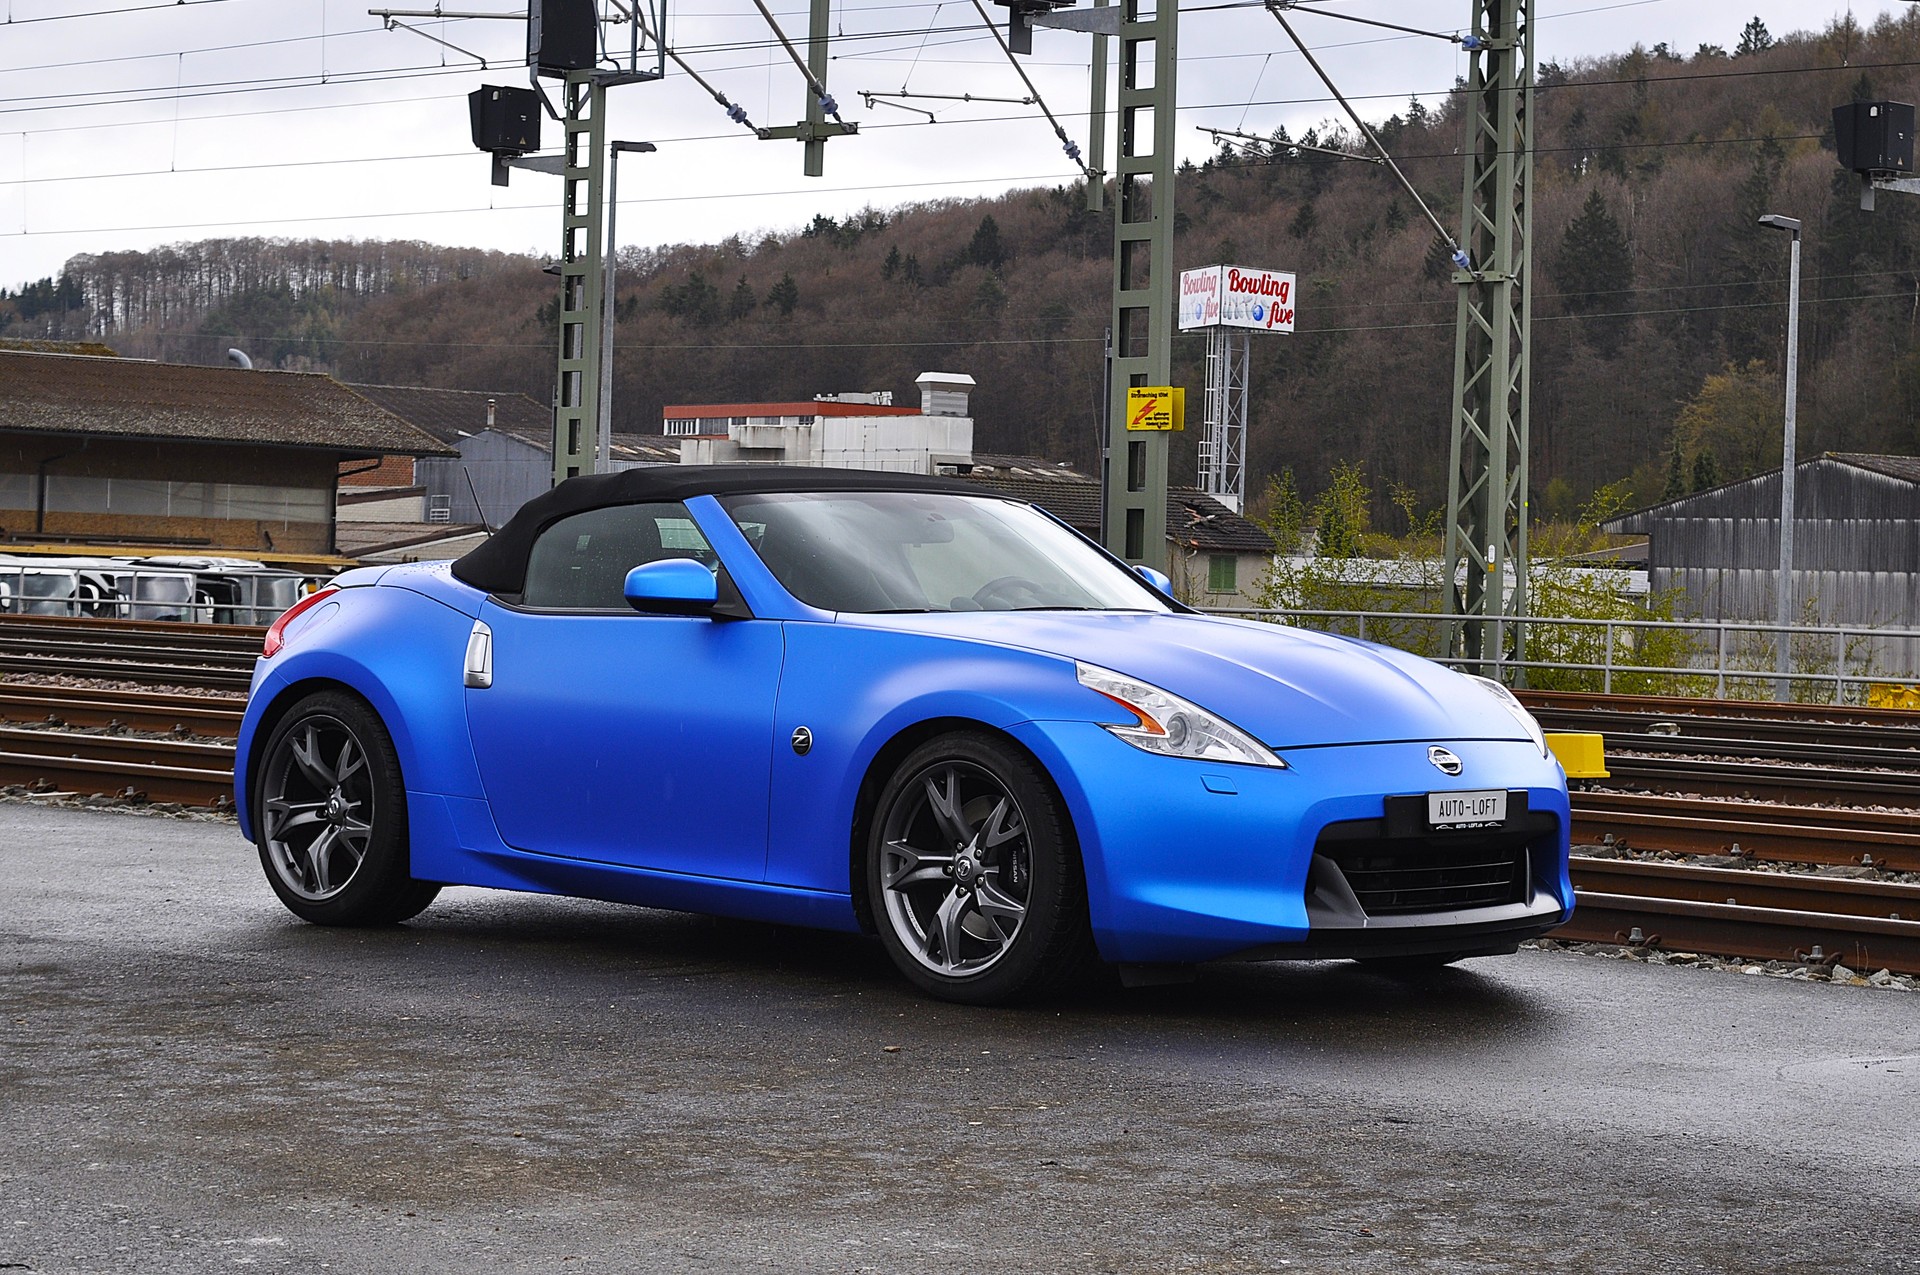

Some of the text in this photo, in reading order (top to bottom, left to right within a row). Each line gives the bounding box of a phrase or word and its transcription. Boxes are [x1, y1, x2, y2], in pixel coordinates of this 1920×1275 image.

[1183, 271, 1217, 298] Bowling
[1228, 268, 1290, 304] Bowling
[1267, 301, 1294, 328] five
[1439, 798, 1497, 818] AUTO-LOFT
